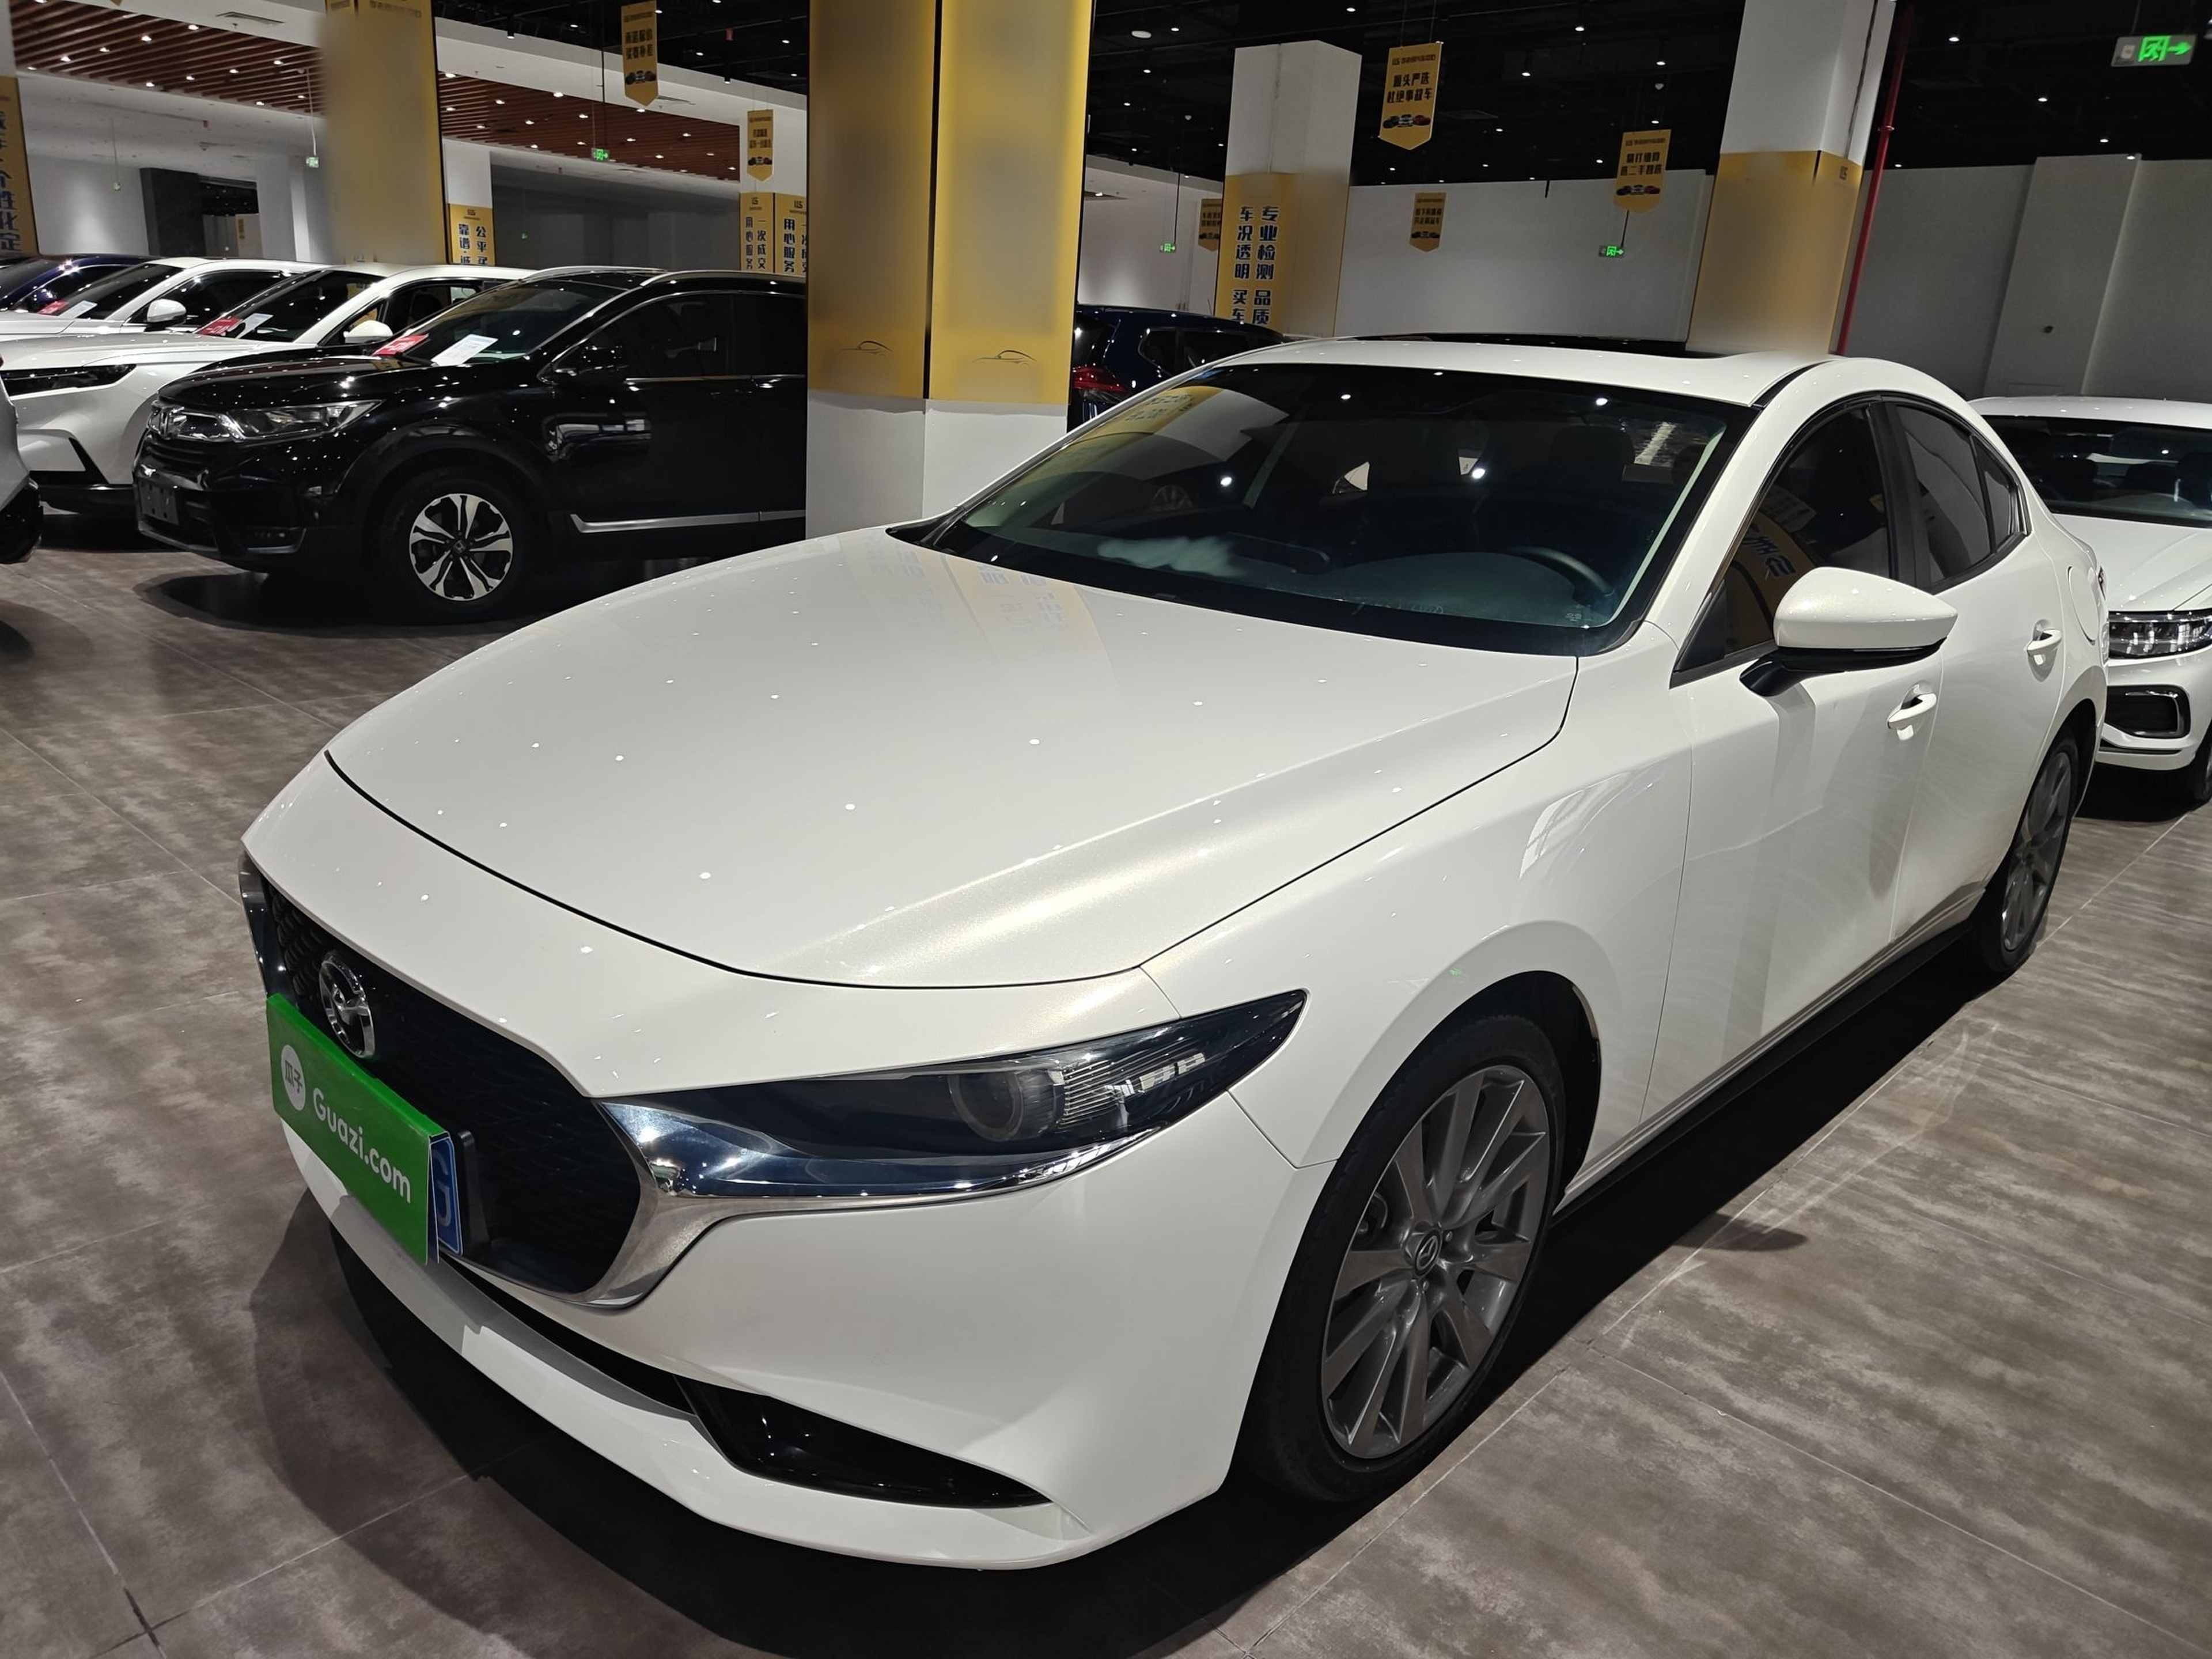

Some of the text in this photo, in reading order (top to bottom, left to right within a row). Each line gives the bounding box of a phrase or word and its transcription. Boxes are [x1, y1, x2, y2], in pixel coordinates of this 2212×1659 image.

[757, 220, 766, 269] 一次成交
[783, 218, 795, 272] 用心服务
[1232, 206, 1253, 322] 车况透明 买车
[1252, 206, 1279, 324] 专业检测 品质
[313, 1087, 411, 1204] Guazi.com
